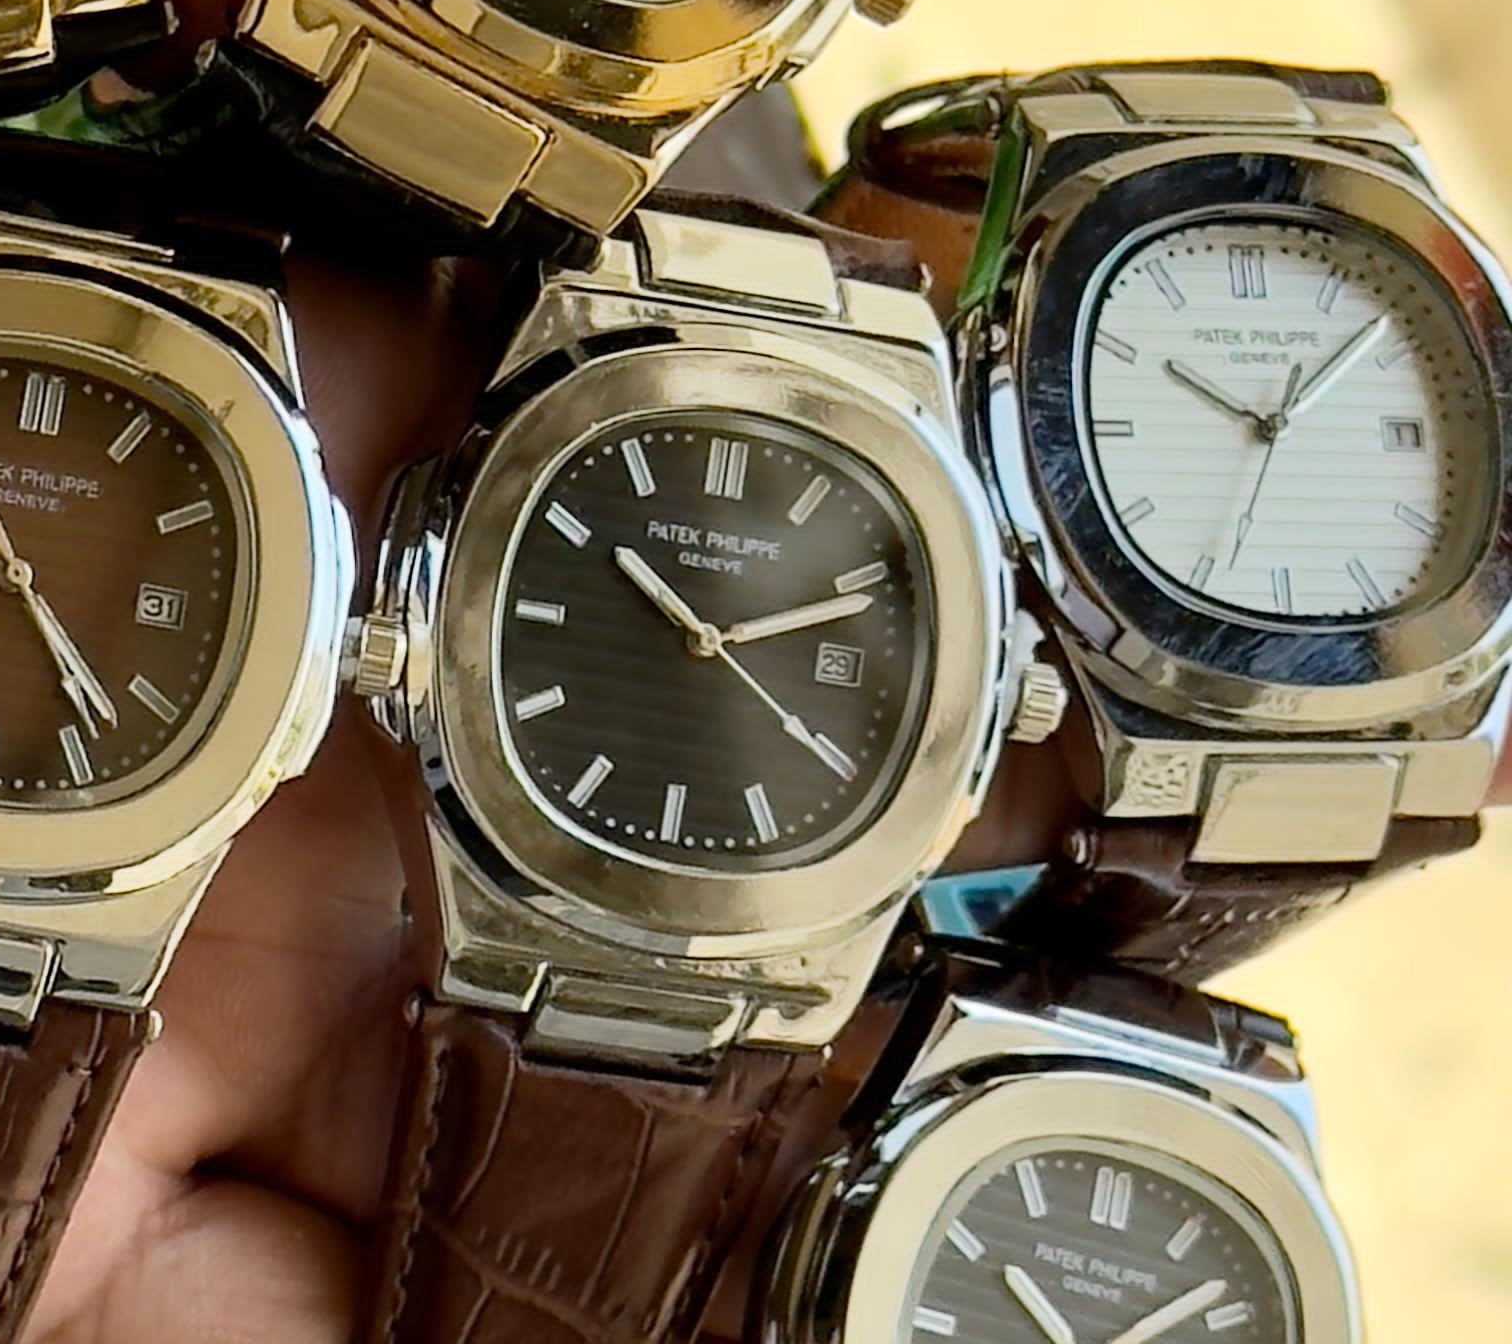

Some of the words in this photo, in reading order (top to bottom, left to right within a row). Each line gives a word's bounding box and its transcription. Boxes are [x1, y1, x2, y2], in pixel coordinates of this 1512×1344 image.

[1193, 329, 1242, 345] PATEK
[1249, 329, 1321, 347] PHILIPPE
[20, 469, 100, 499] PHILIPPE
[647, 520, 701, 546] PATEK
[706, 531, 783, 560] PHILIPPE
[678, 551, 744, 576] GENEVE
[143, 595, 174, 619] 31
[1035, 1242, 1086, 1272] PATEK
[1088, 1257, 1159, 1293] PHILIPPE
